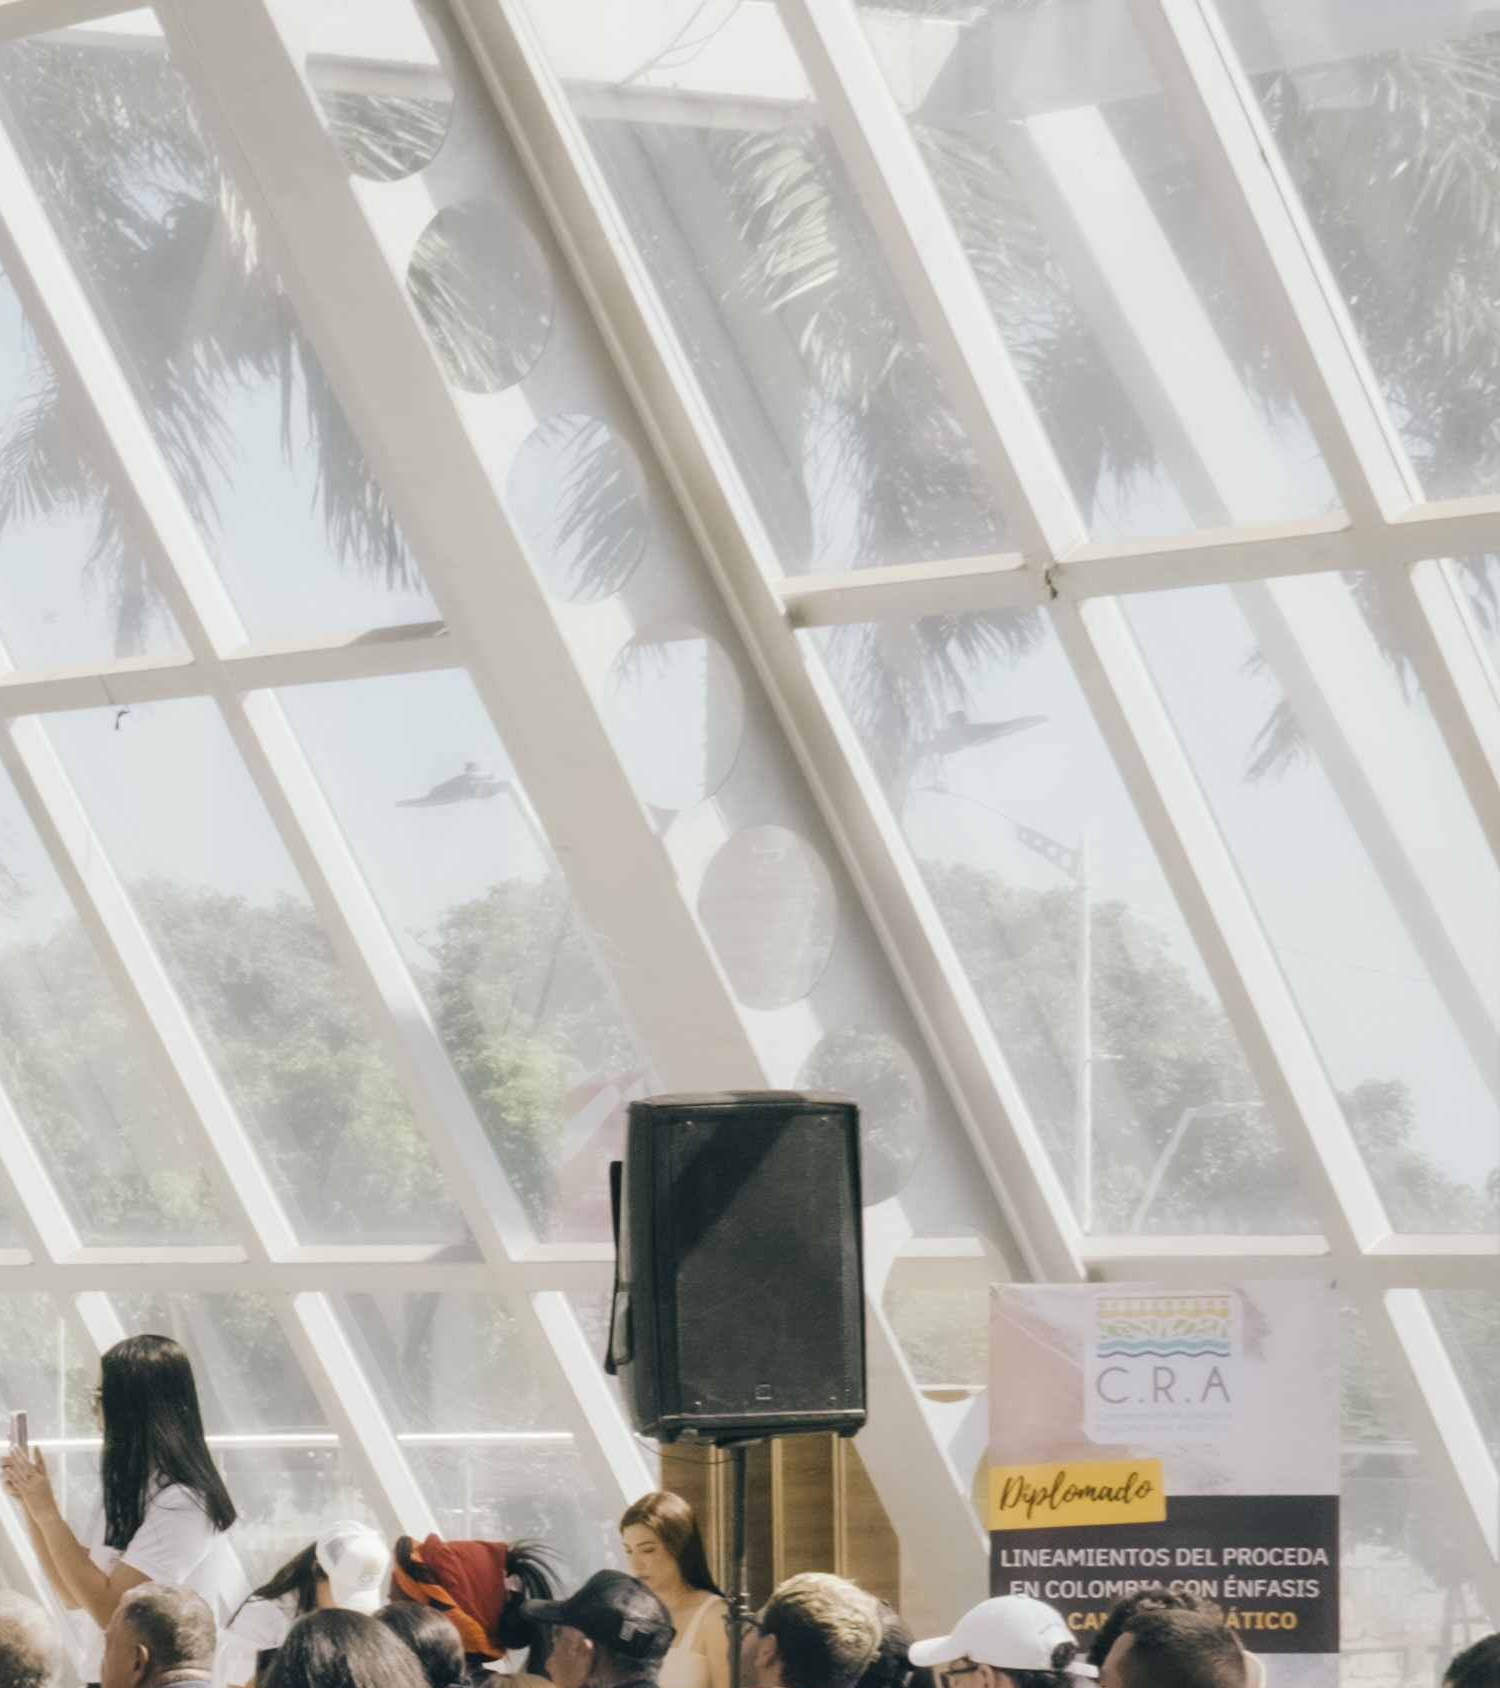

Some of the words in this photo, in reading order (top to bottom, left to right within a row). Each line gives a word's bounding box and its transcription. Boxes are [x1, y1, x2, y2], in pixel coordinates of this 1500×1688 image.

[999, 1470, 1154, 1520] Diplomado
[1001, 1548, 1170, 1567] LINEAMIENTOS
[1176, 1548, 1217, 1567] DEL
[1223, 1547, 1329, 1566] PROCEDA
[1010, 1580, 1039, 1598] EN
[1169, 1579, 1218, 1598] CON
[1224, 1575, 1320, 1598] ÉNFASIS
[1221, 1607, 1298, 1630] ÁTICO
